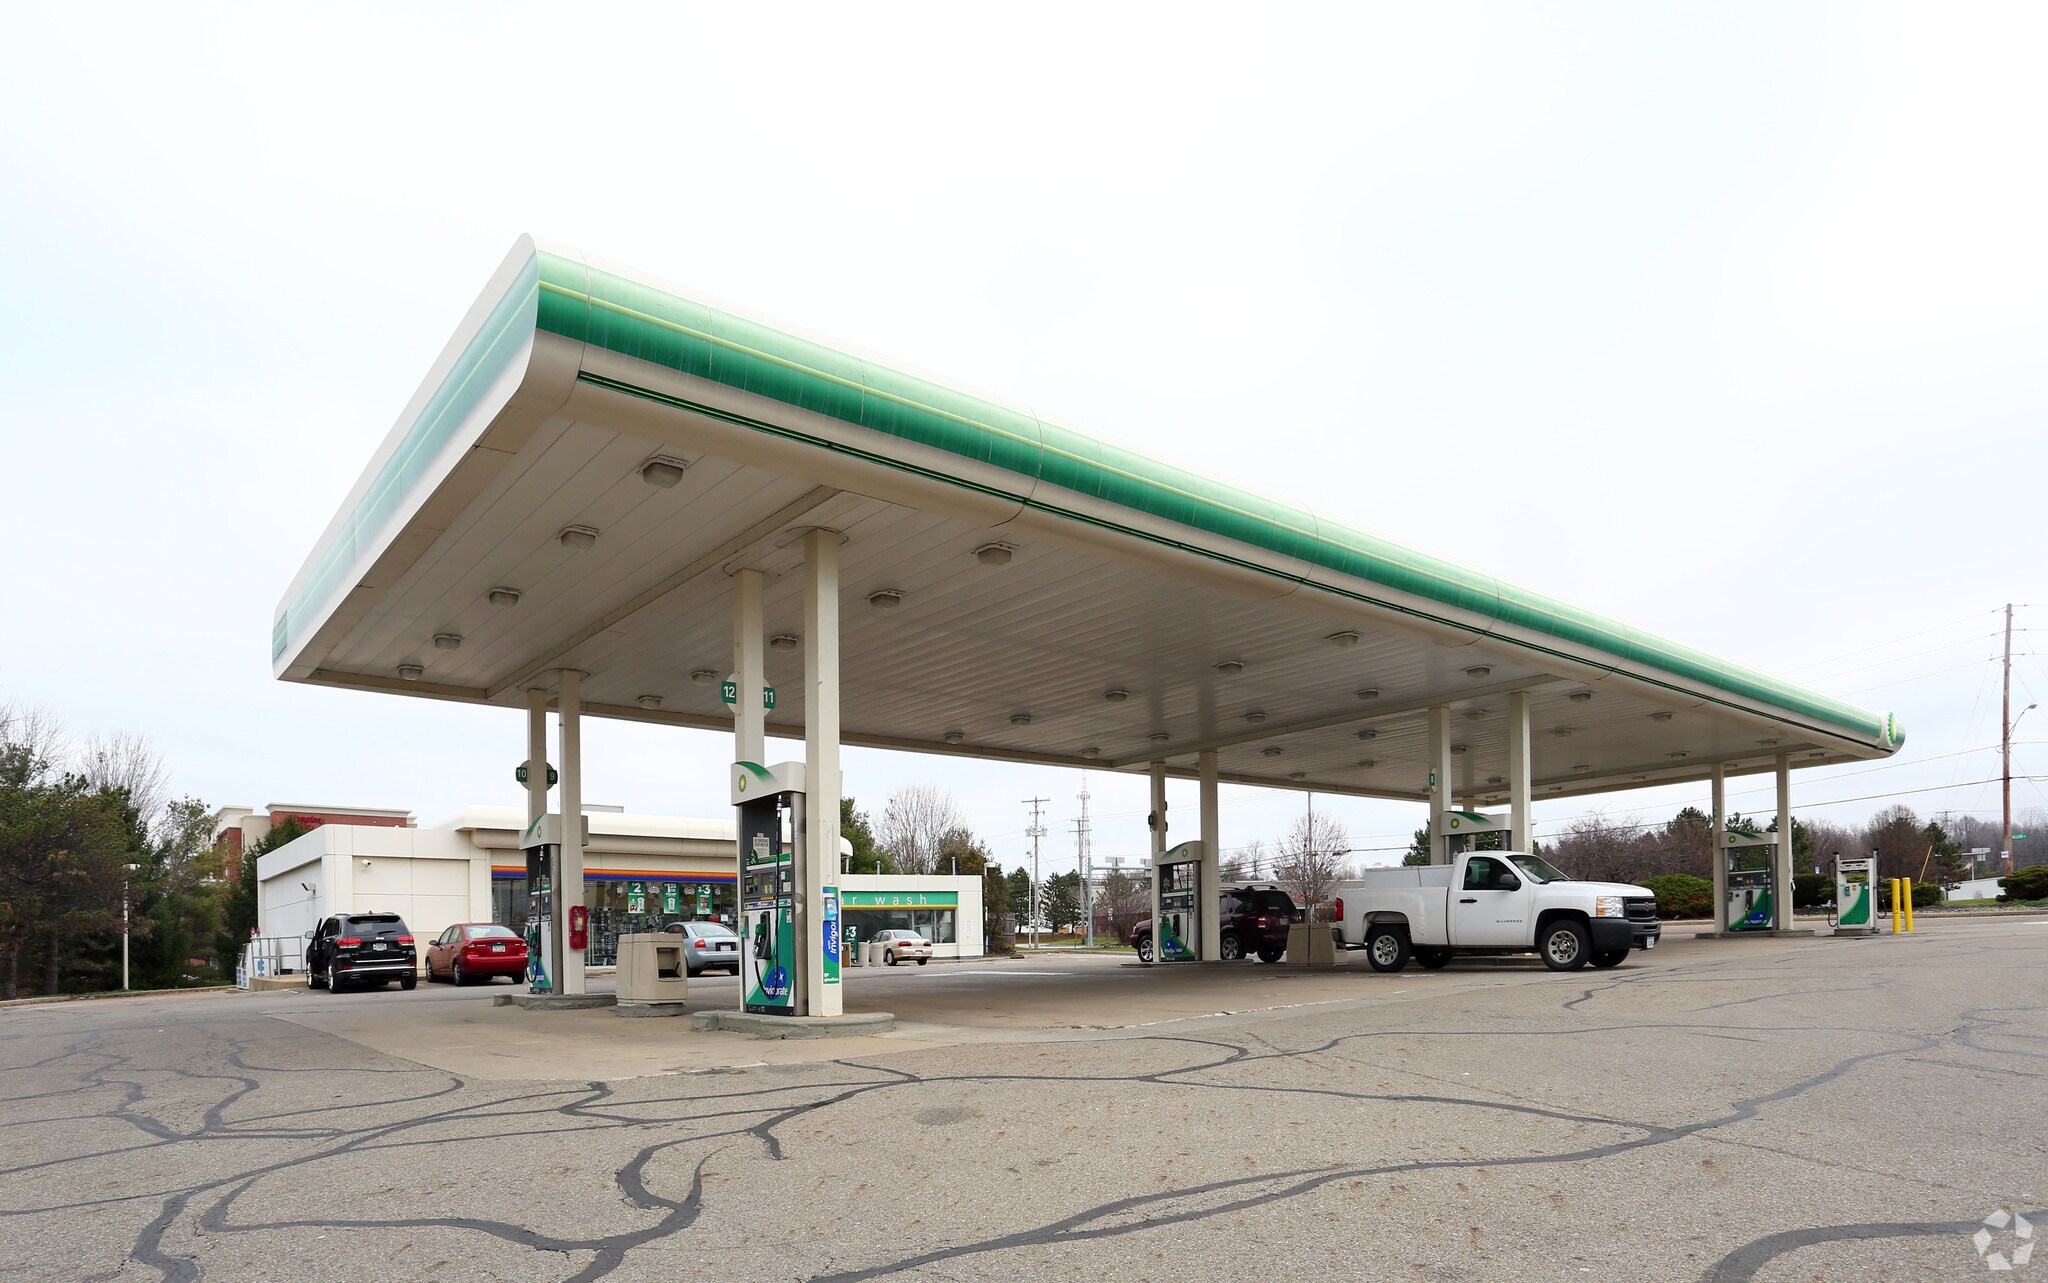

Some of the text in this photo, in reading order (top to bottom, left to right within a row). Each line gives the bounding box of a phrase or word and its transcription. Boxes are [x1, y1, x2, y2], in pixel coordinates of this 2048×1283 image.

[723, 686, 736, 698] 12
[763, 691, 774, 703] 11
[517, 769, 527, 778] 10
[549, 772, 555, 781] 9
[875, 894, 927, 905] wash
[830, 911, 839, 954] Invigor
